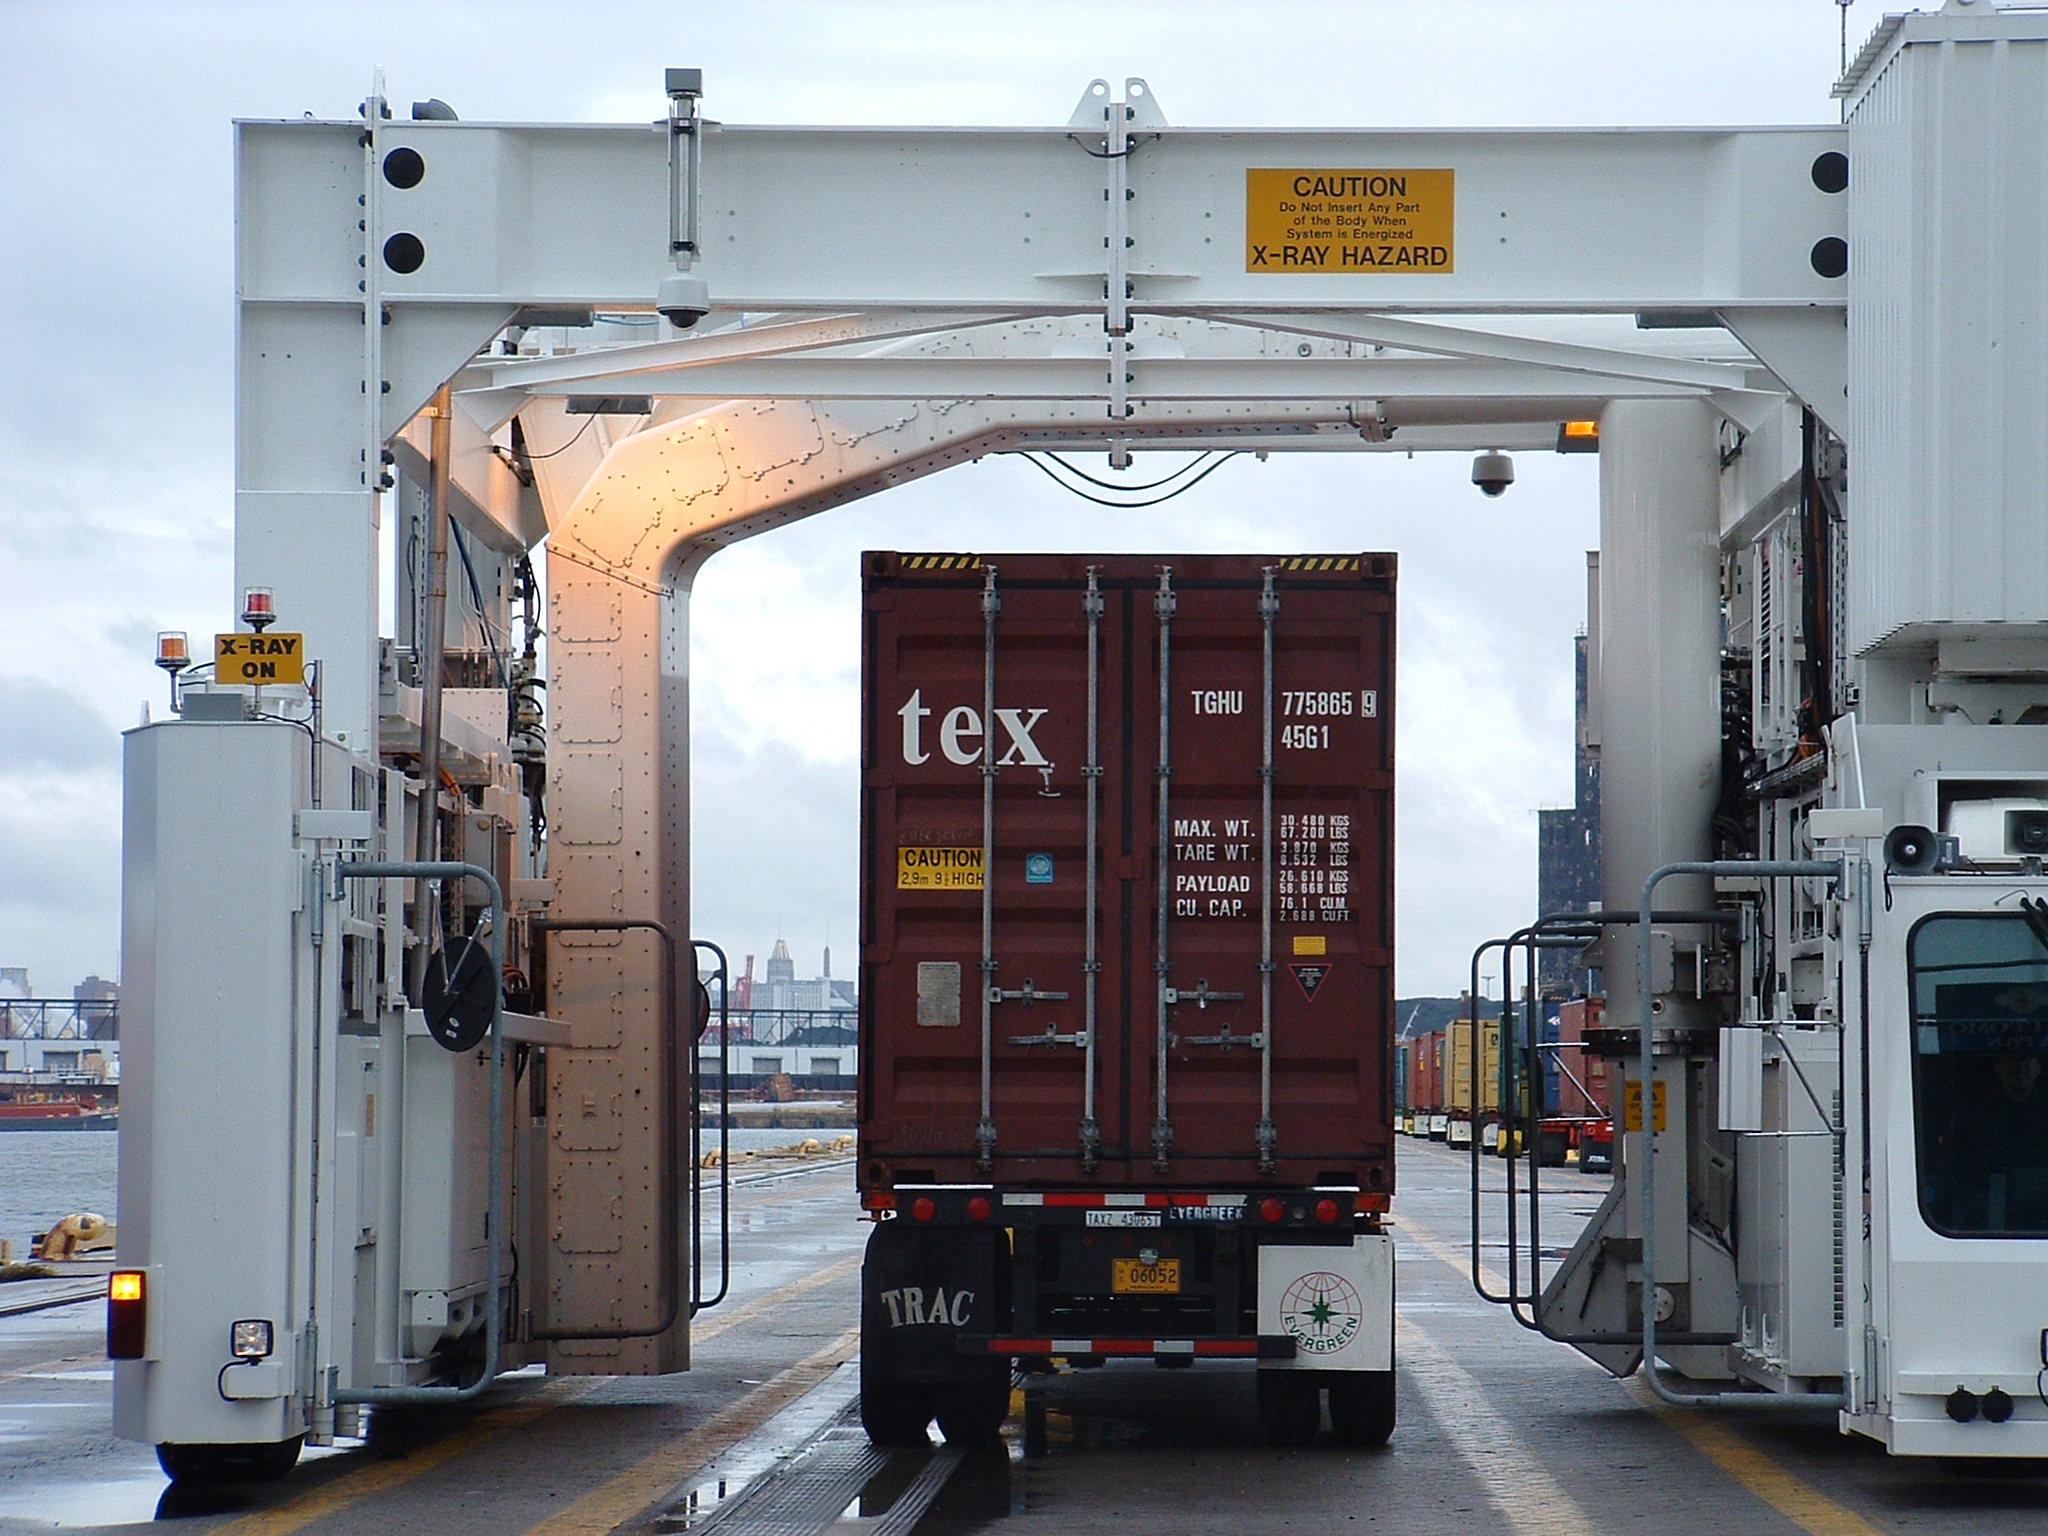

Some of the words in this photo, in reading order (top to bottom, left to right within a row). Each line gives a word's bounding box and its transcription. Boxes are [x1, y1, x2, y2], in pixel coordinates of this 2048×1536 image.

[1293, 176, 1406, 197] CAUTION
[1280, 203, 1296, 213] Do
[1301, 202, 1323, 213] Not
[1328, 202, 1362, 213] Insert
[1368, 202, 1390, 214] Any
[1396, 202, 1420, 213] Part
[1293, 215, 1305, 226] of
[1312, 215, 1331, 226] the
[1337, 215, 1367, 228] Body
[1373, 215, 1406, 226] When
[1287, 229, 1332, 241] System
[1338, 228, 1348, 239] is
[1353, 228, 1413, 241] Energized
[1252, 245, 1330, 266] X-RAY
[1342, 245, 1448, 266] HAZARD
[220, 638, 297, 655] X-RAY
[241, 662, 276, 678] ON
[1191, 690, 1243, 715] TGHU
[1282, 691, 1353, 716] 775865
[1363, 691, 1375, 716] 9
[897, 688, 1049, 766] tex
[1281, 725, 1329, 749] 45G1
[1174, 820, 1217, 838] MAX.
[1224, 820, 1256, 838] WT.
[1280, 815, 1325, 826] 30.480
[1330, 815, 1350, 826] KGS
[1330, 827, 1349, 839] LBS
[905, 849, 982, 868] CAUTION
[1175, 844, 1216, 861] TARE
[1224, 844, 1256, 861] WT.
[1330, 841, 1350, 853] KGS
[1330, 854, 1348, 866] LBS
[952, 872, 985, 885] HIGH
[1176, 875, 1251, 893] PAYLOAD
[1329, 870, 1349, 882] KGS
[1329, 882, 1348, 894] LBS
[1176, 899, 1203, 917] CU.
[1209, 899, 1248, 917] CAP.
[1130, 1268, 1177, 1284] 06052
[880, 1286, 975, 1328] TRAC
[1284, 1315, 1358, 1351] EVERGREEN
